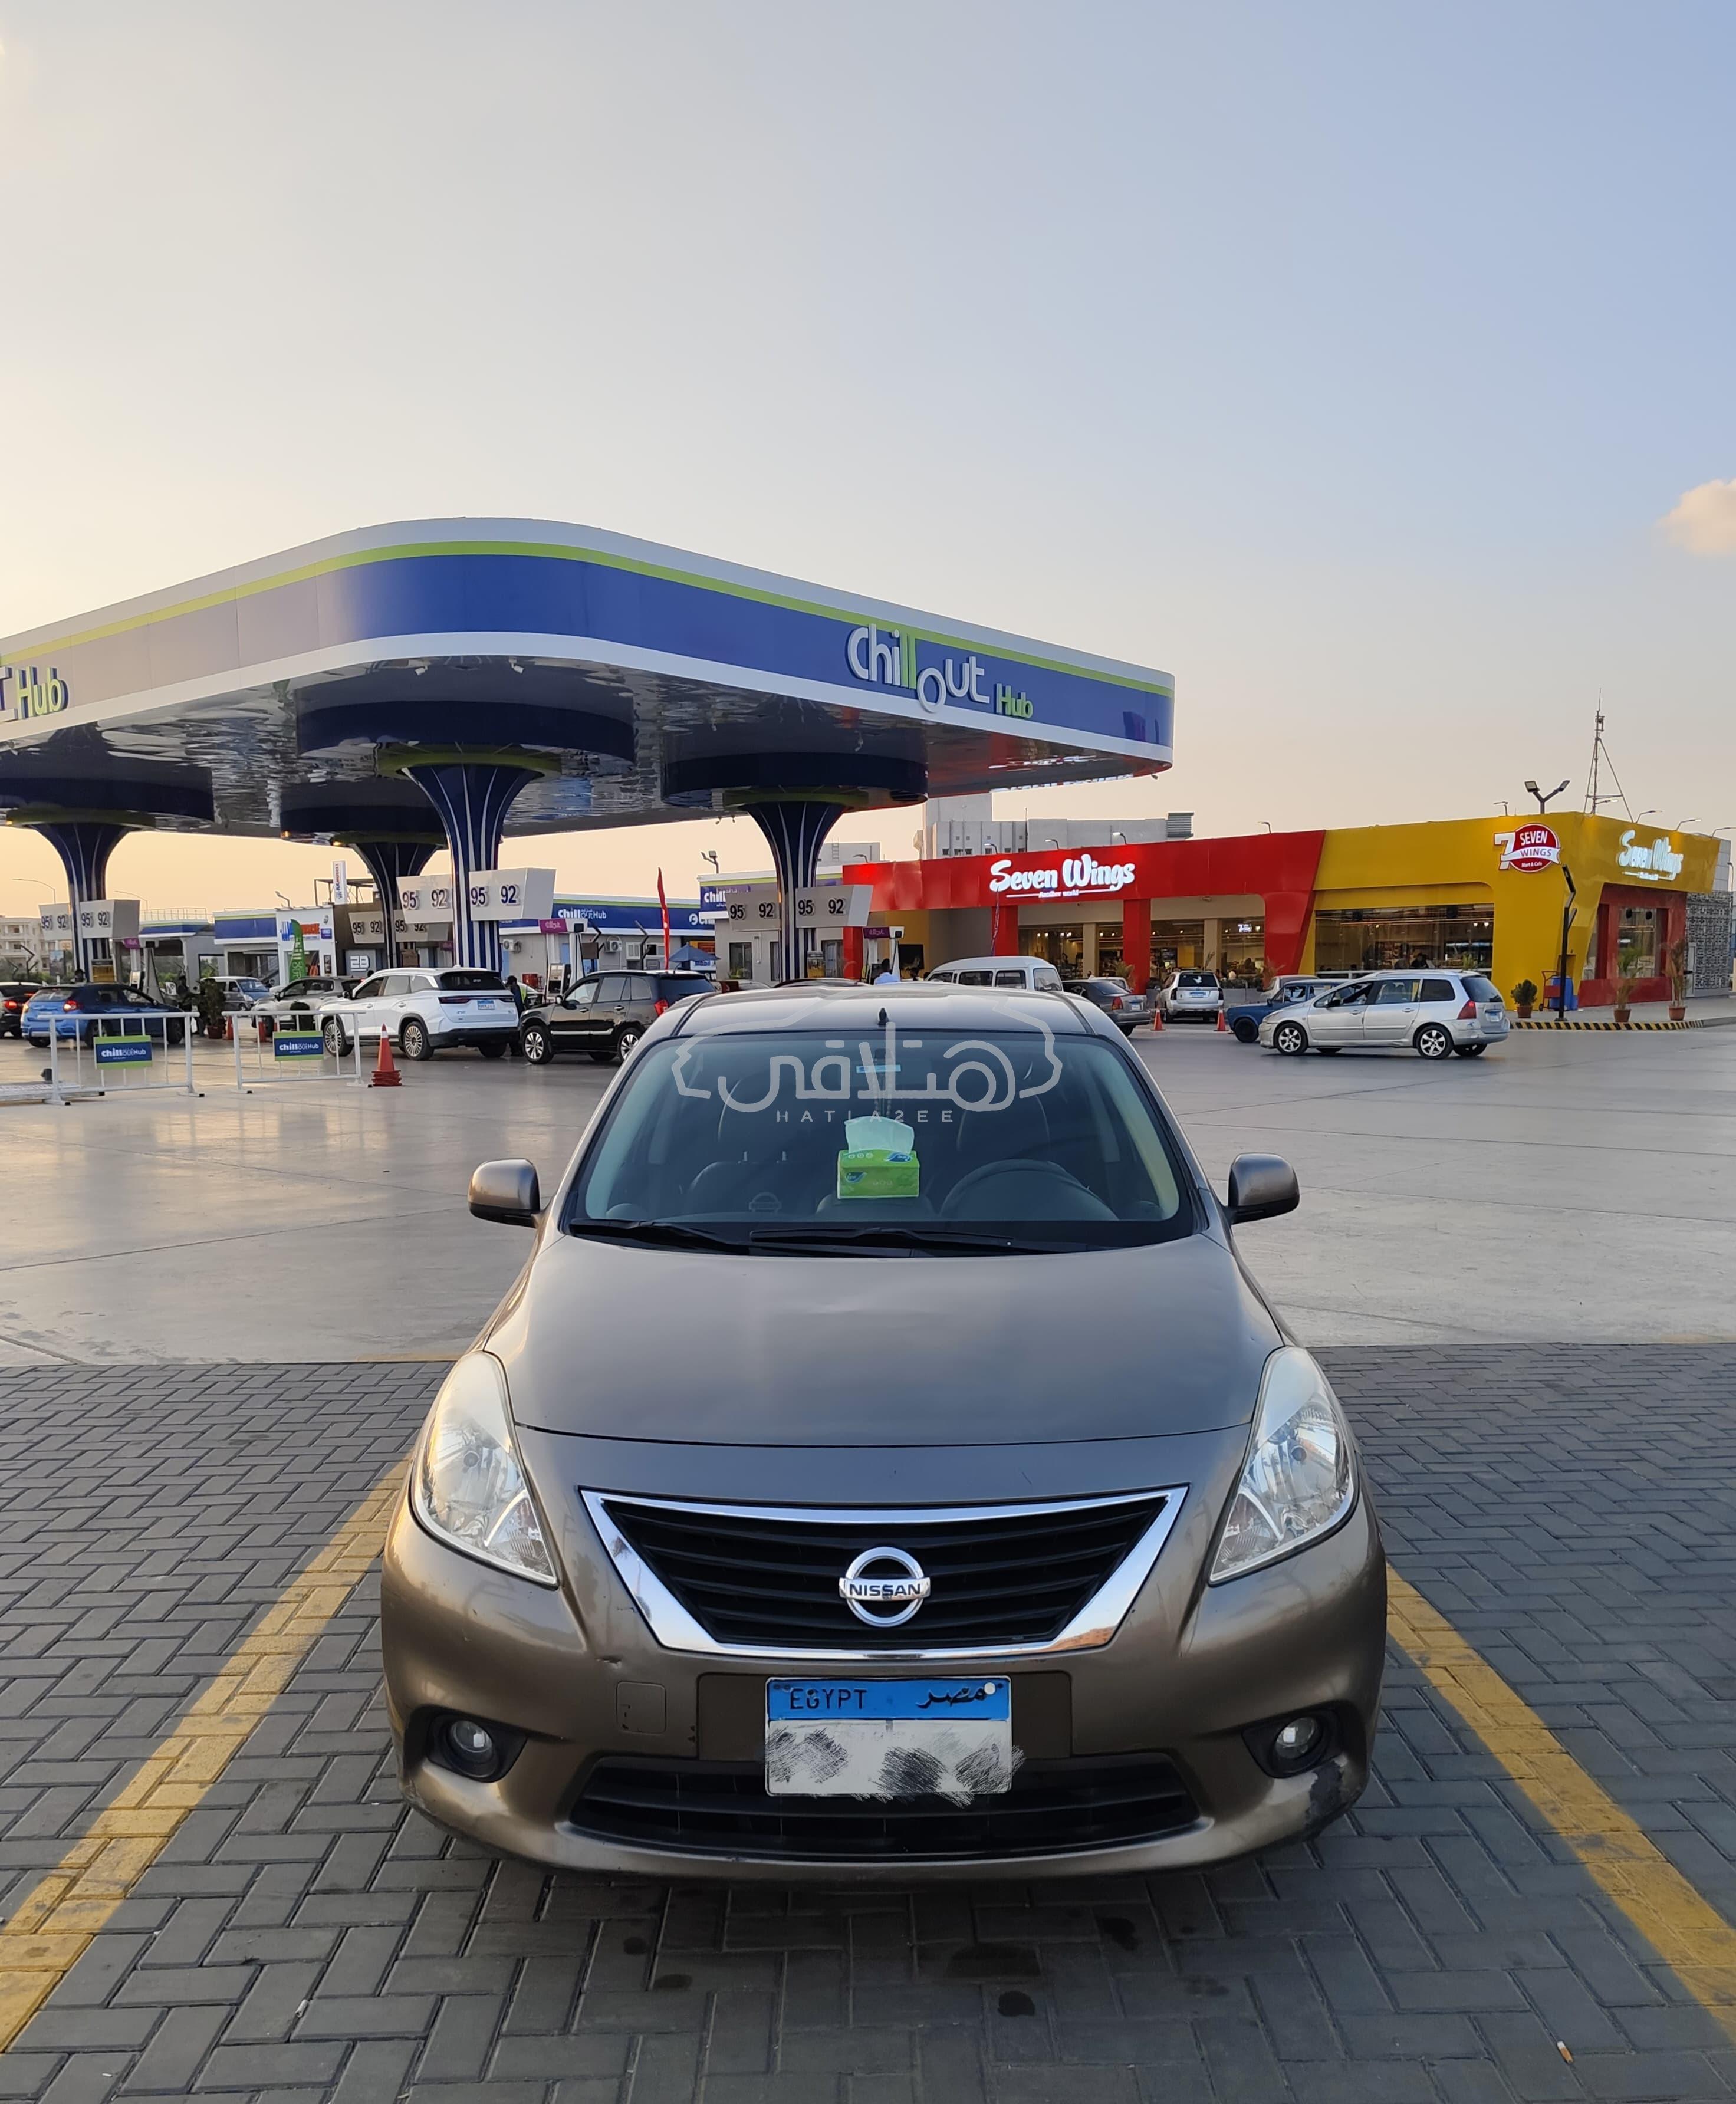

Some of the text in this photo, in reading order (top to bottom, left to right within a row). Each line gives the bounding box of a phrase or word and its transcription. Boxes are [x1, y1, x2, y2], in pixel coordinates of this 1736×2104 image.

[16, 665, 68, 719] Hub
[995, 683, 1034, 718] Hub
[1520, 830, 1548, 846] SEVEN
[1494, 831, 1515, 870] 7
[1520, 849, 1552, 857] WINGS
[989, 854, 1135, 892] Seven Wings
[402, 889, 448, 908] 95 92
[471, 885, 517, 905] 95 92
[593, 910, 607, 919] Hub
[730, 903, 774, 919] 95 92
[798, 899, 844, 915] 95 92
[41, 915, 67, 929] 95 92
[81, 912, 108, 927] 95 92
[353, 921, 380, 933] 95 92
[395, 920, 425, 932] 95 92
[849, 1583, 921, 1597] NISSAN
[790, 1688, 867, 1710] EGYPT
[916, 1687, 987, 1710] مصر
